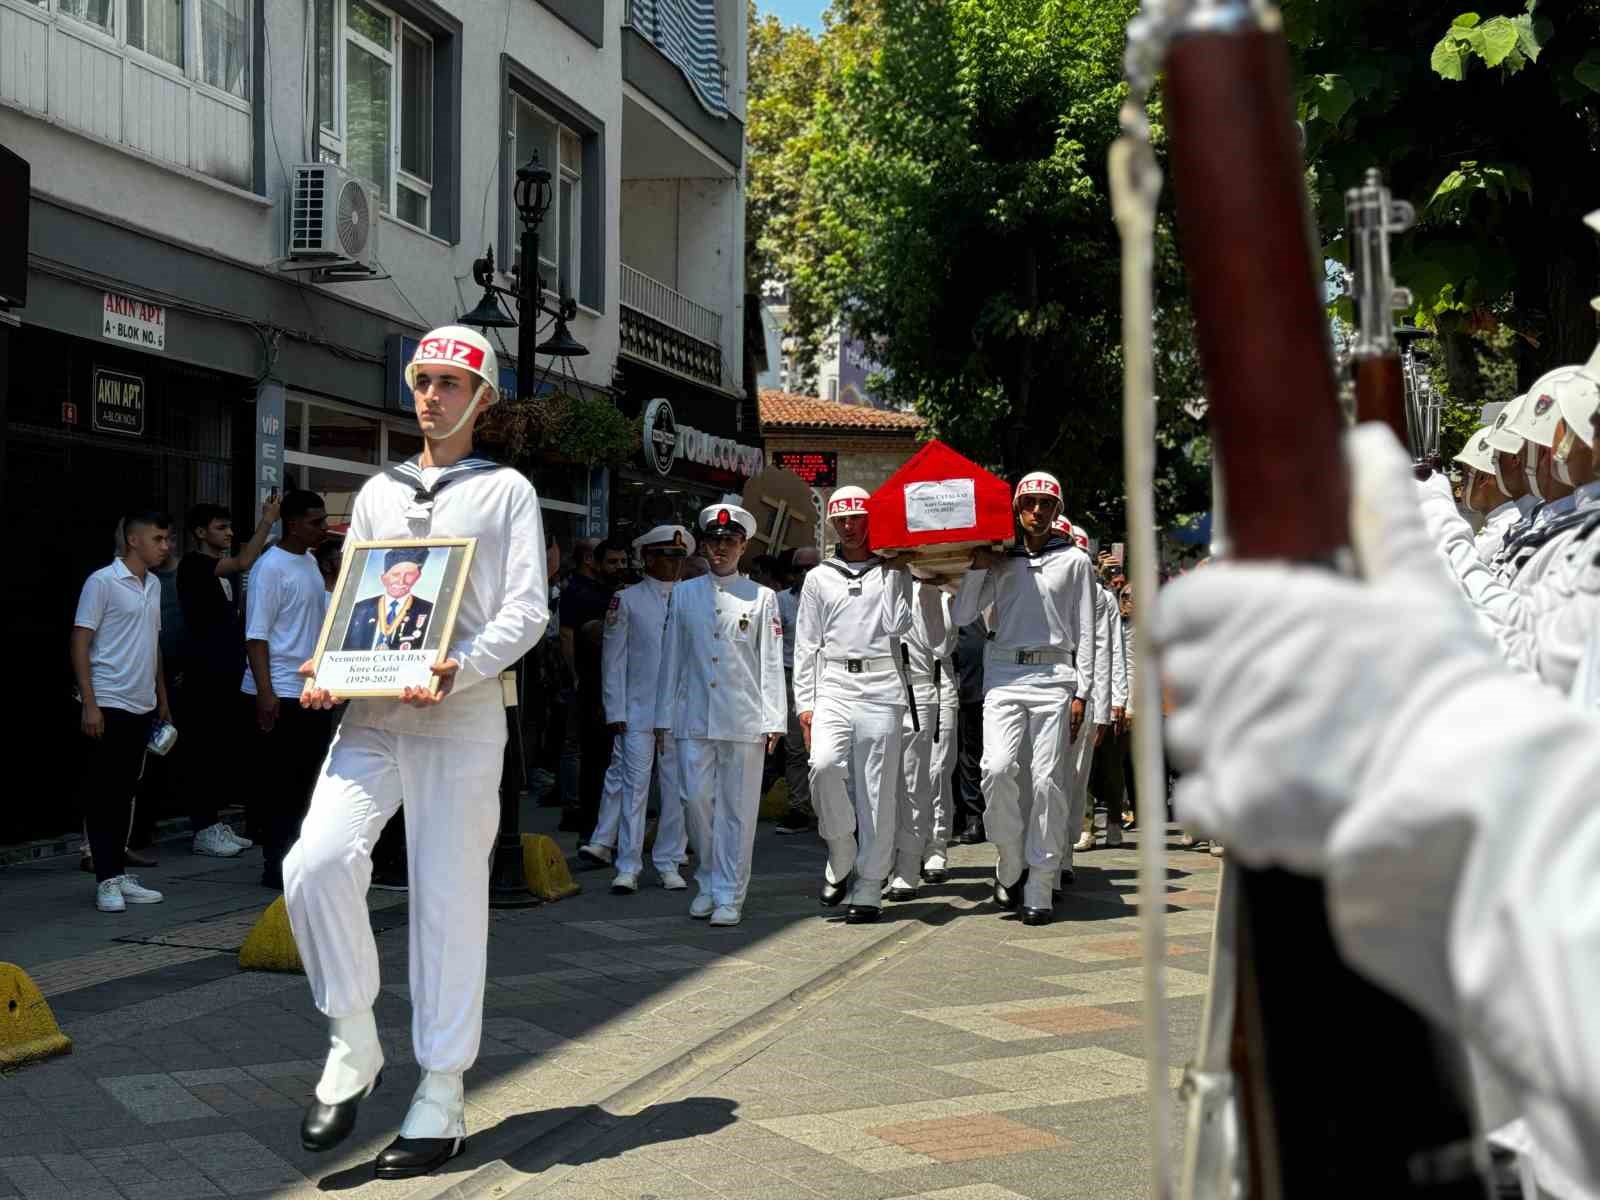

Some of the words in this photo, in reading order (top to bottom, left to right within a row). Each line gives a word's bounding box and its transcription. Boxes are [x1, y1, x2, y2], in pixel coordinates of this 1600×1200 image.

[104, 293, 136, 318] AKIN
[97, 379, 121, 406] AKIN
[122, 383, 141, 409] APT.
